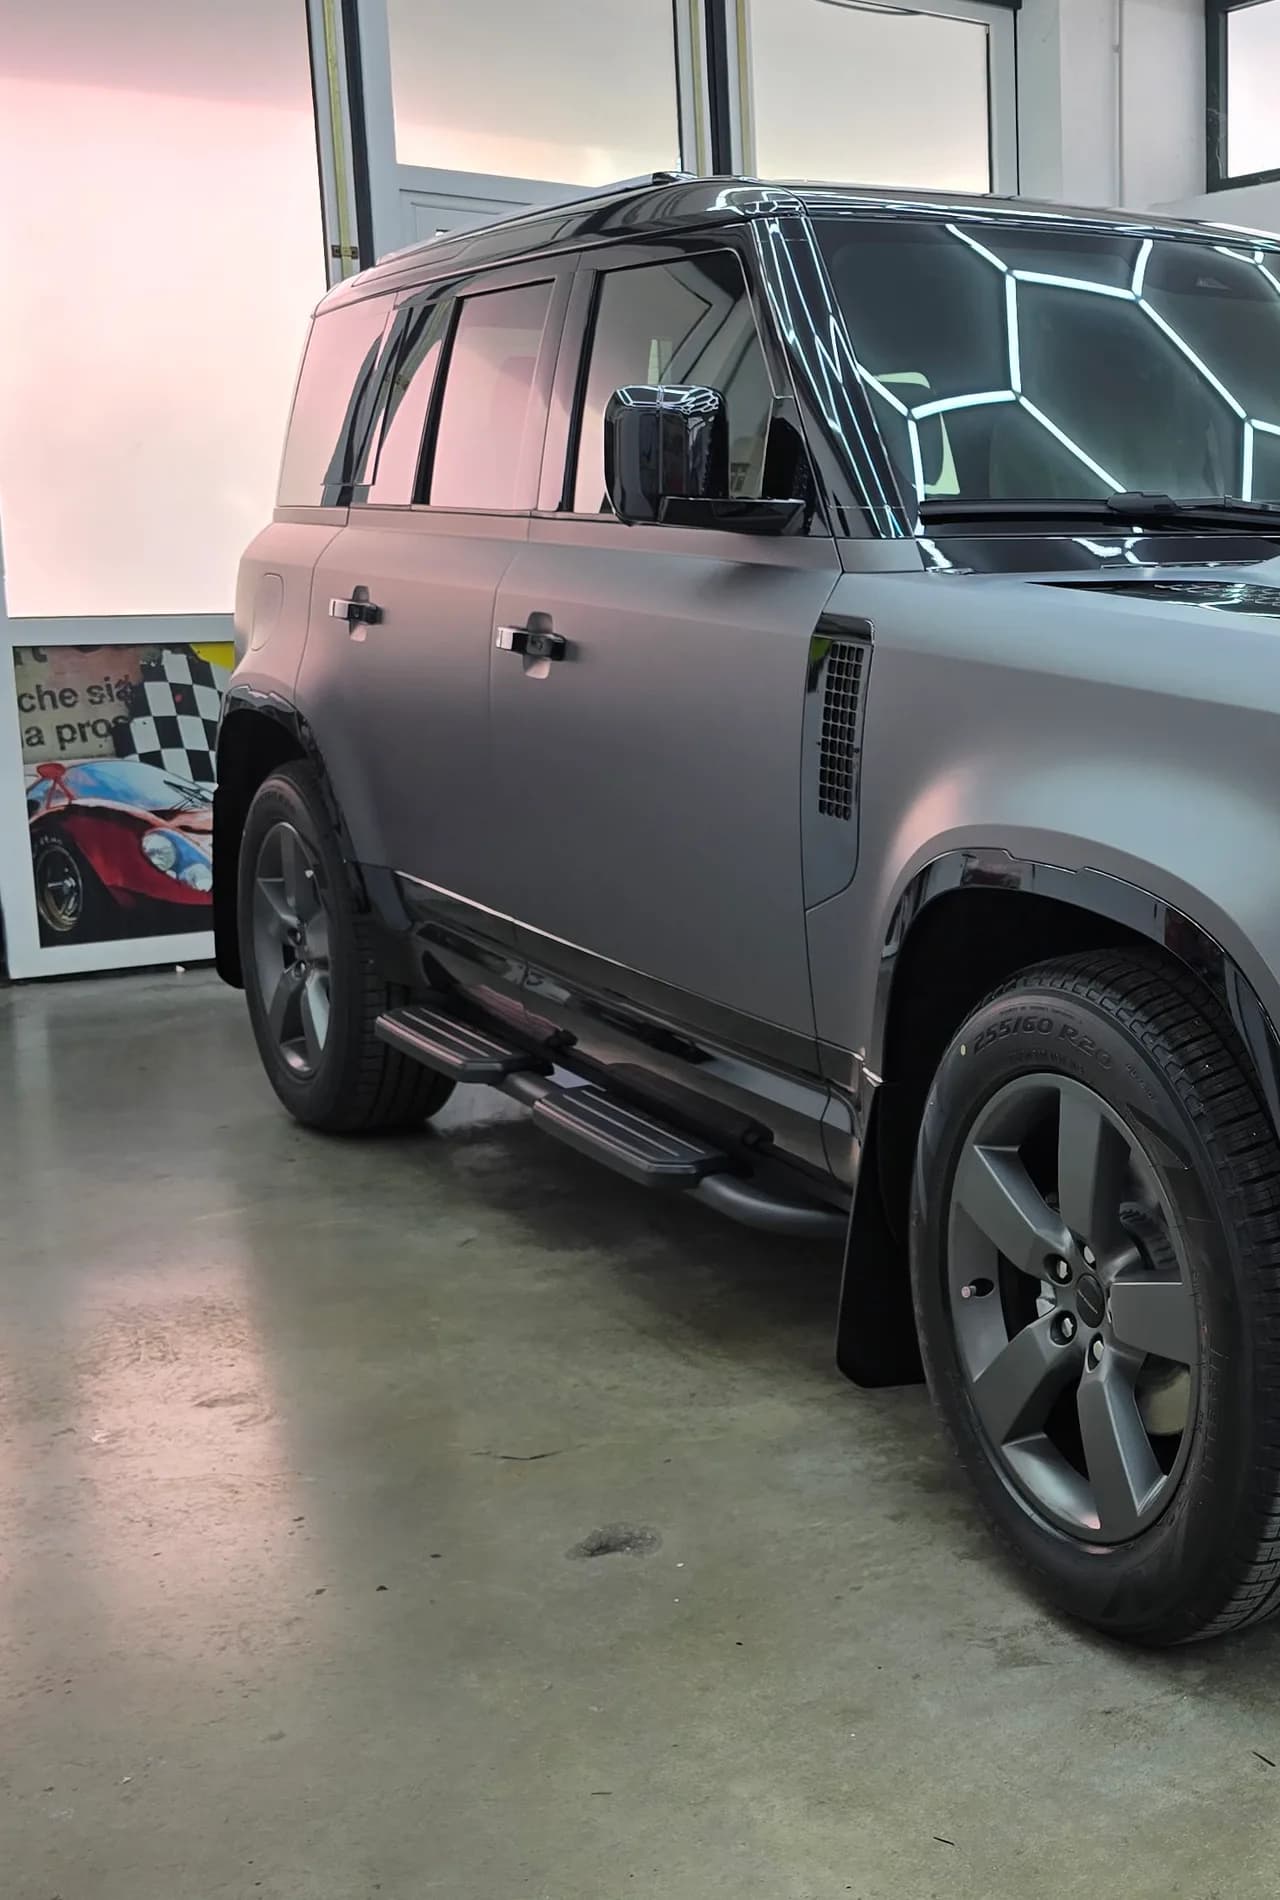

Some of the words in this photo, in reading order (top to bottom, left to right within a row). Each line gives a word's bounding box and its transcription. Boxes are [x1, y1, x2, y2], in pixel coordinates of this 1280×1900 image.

[18, 684, 78, 712] che
[974, 1015, 1054, 1056] 255/60
[1057, 1024, 1113, 1070] R20
